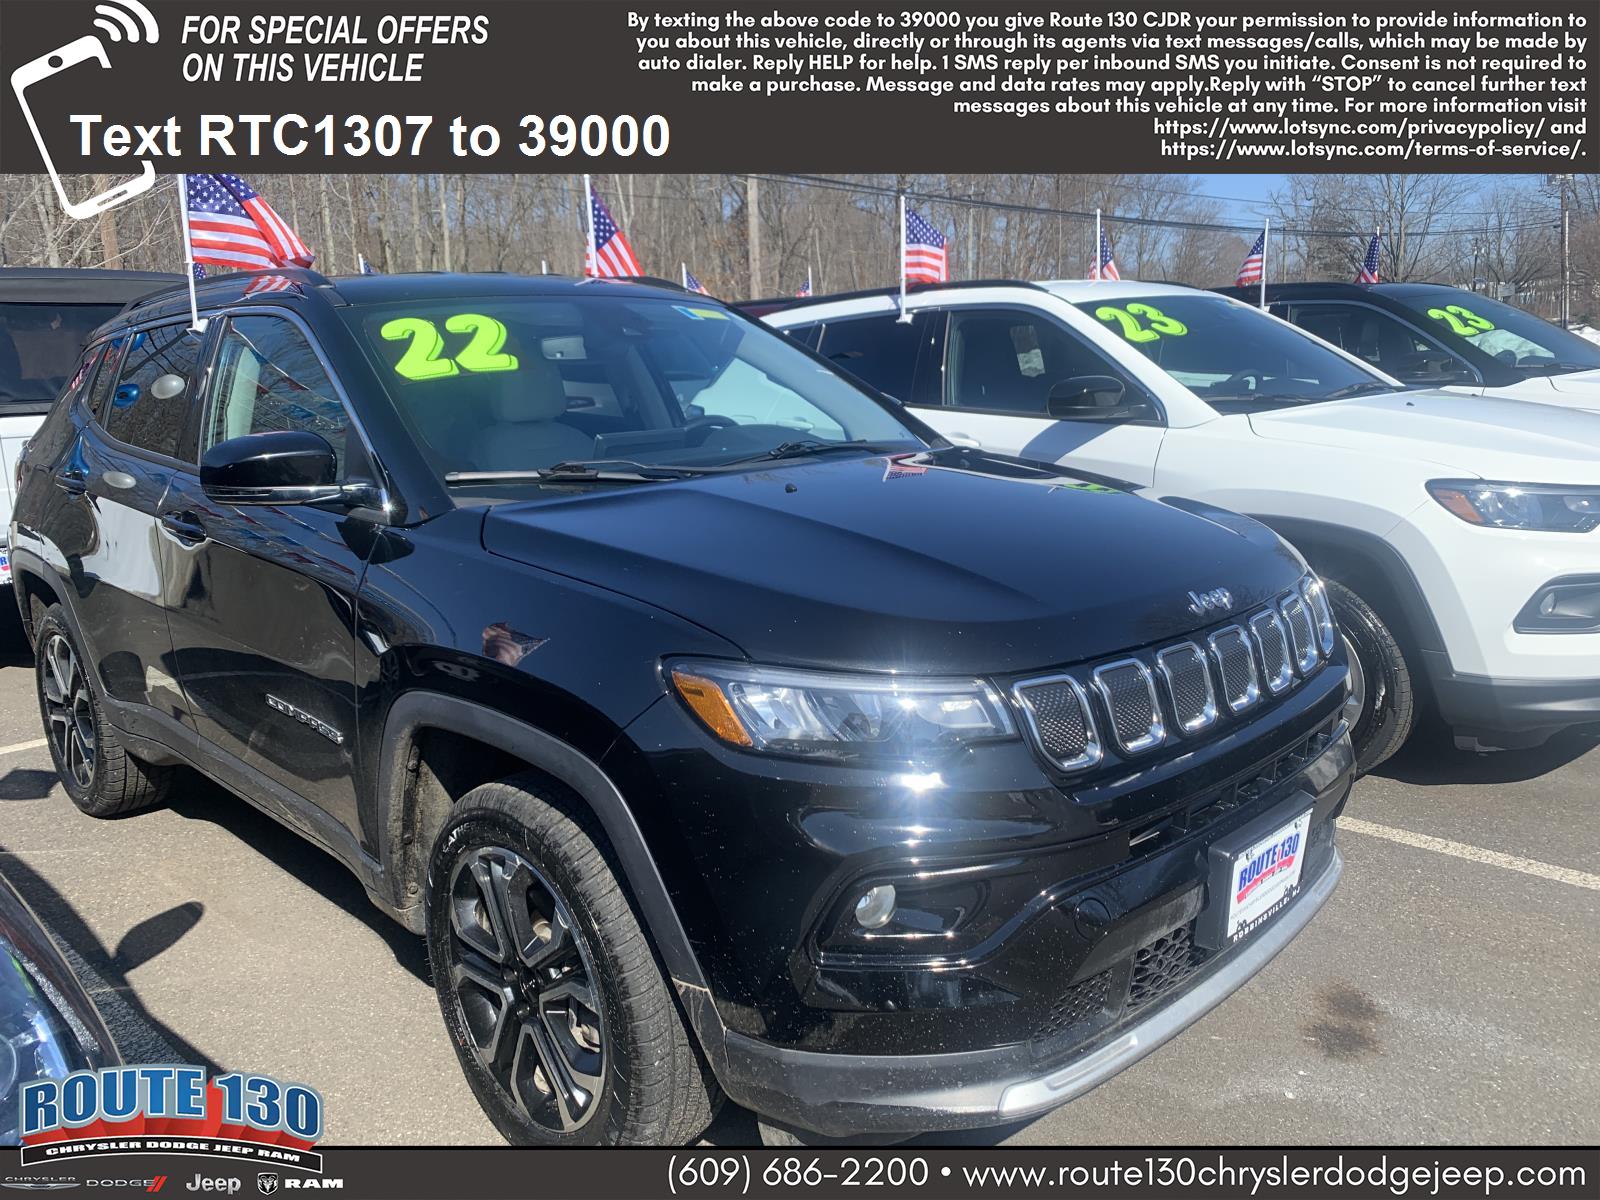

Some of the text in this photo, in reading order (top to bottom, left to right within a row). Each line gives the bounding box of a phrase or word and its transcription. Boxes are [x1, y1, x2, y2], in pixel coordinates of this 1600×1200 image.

[1096, 303, 1188, 343] 23
[1428, 305, 1496, 336] 23
[380, 313, 519, 381] 22
[1187, 588, 1233, 616] Jeep
[1238, 843, 1278, 892] ROUTE
[1280, 833, 1300, 859] 130
